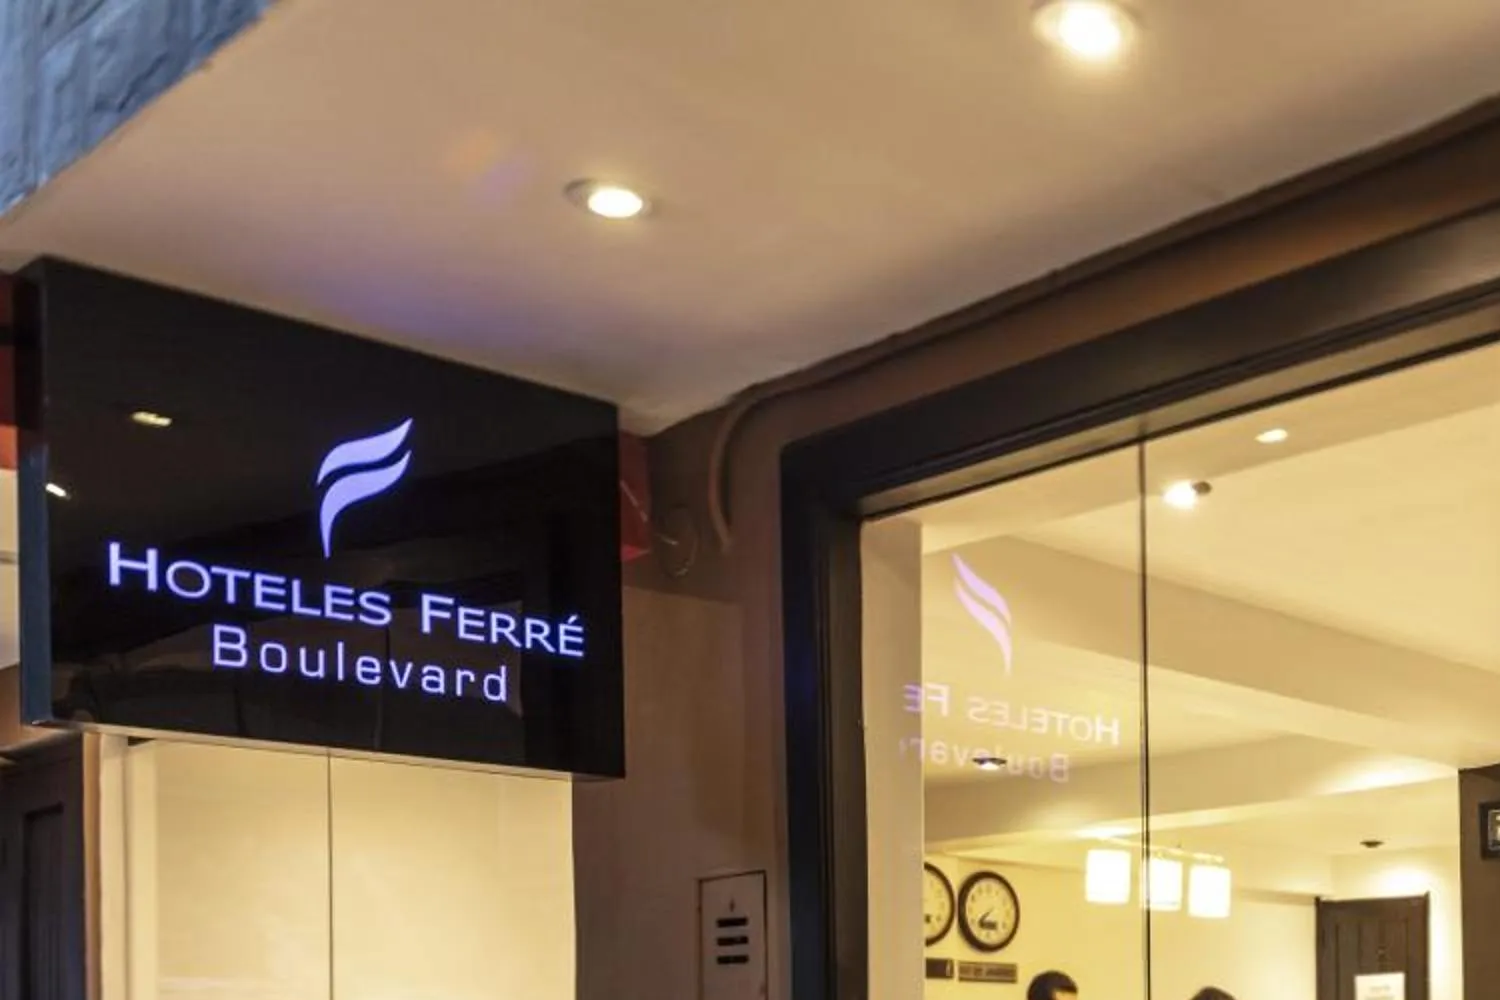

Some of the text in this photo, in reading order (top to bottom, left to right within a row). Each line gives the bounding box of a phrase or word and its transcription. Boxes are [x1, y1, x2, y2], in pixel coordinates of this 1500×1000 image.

[108, 541, 585, 659] HOTELES FERRÉ
[212, 623, 508, 702] Boulevard
